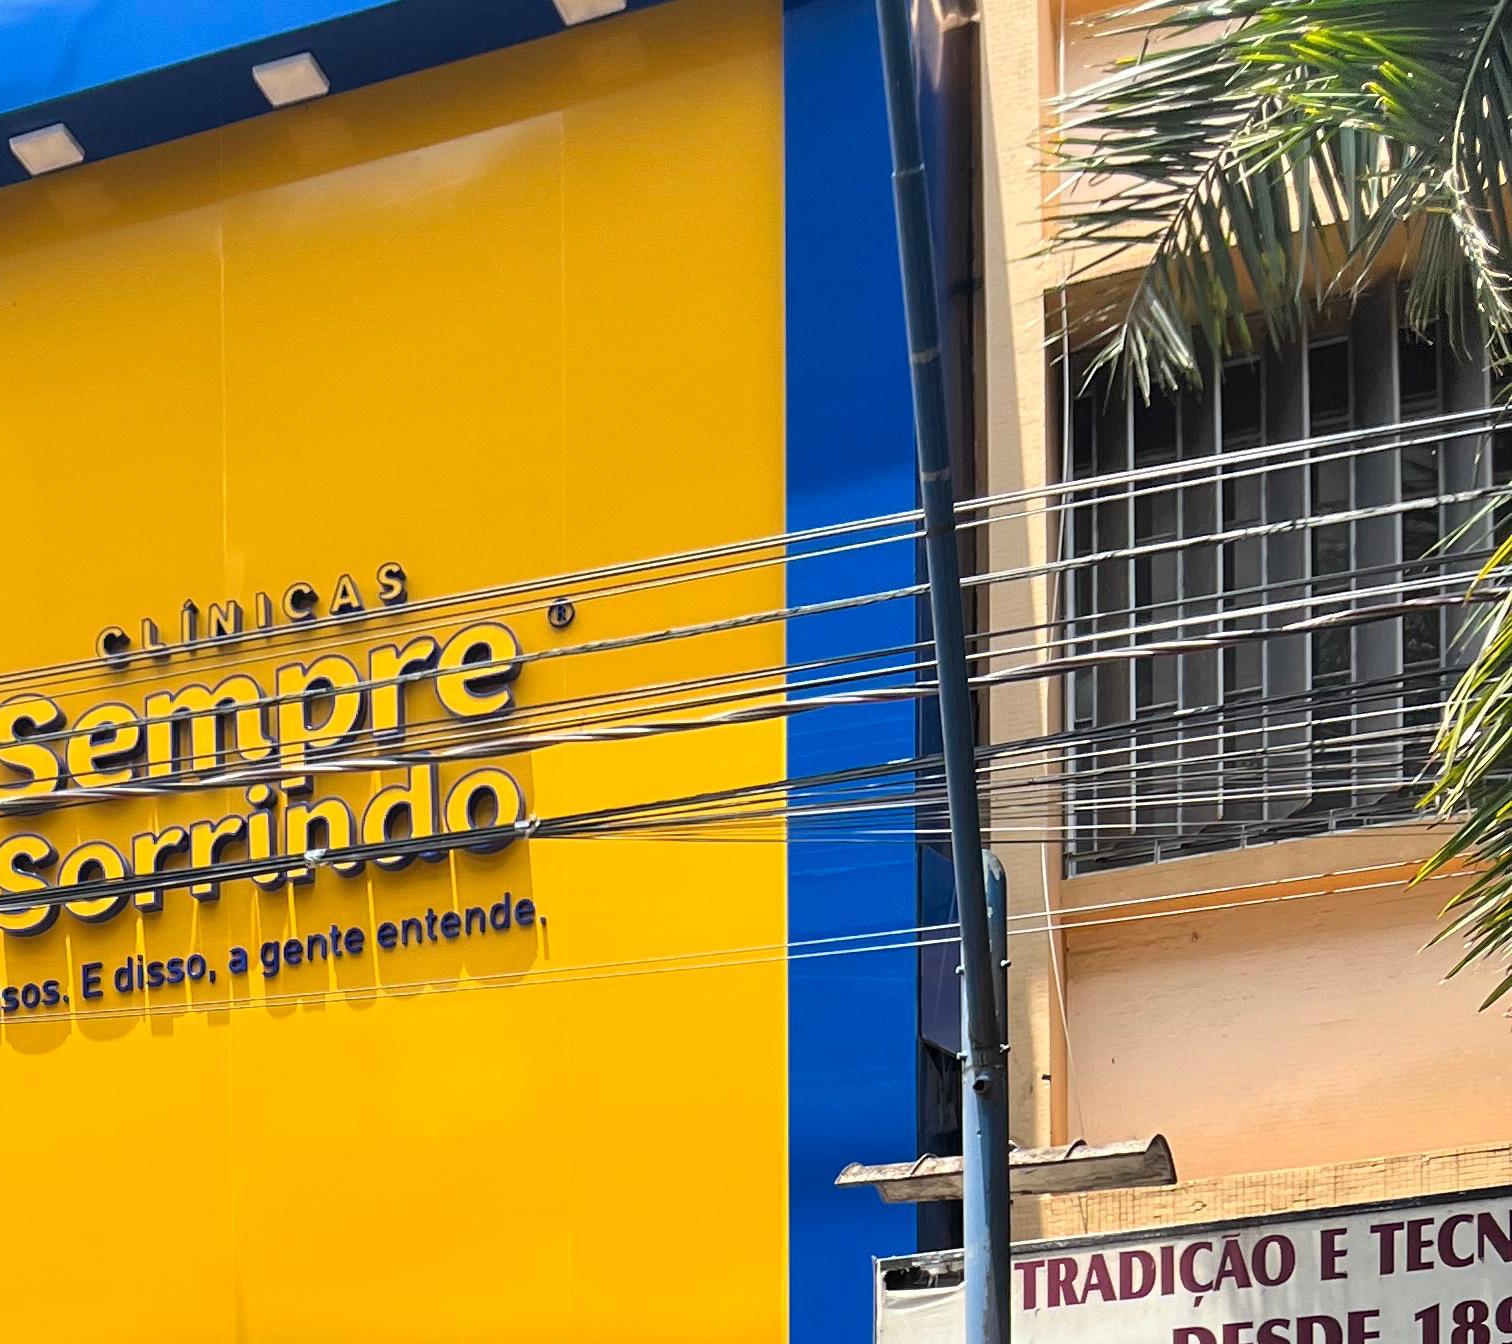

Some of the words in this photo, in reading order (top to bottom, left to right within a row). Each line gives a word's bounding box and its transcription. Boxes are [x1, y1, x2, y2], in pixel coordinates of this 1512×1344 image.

[96, 561, 409, 668] CLÍNICAS
[82, 961, 105, 1000] E
[114, 953, 216, 993] disso,
[228, 945, 248, 975] a
[260, 923, 365, 977] gente
[1014, 1233, 1296, 1311] TRADIÇÃO
[1320, 1228, 1348, 1281] E
[1370, 1210, 1512, 1276] TECN
